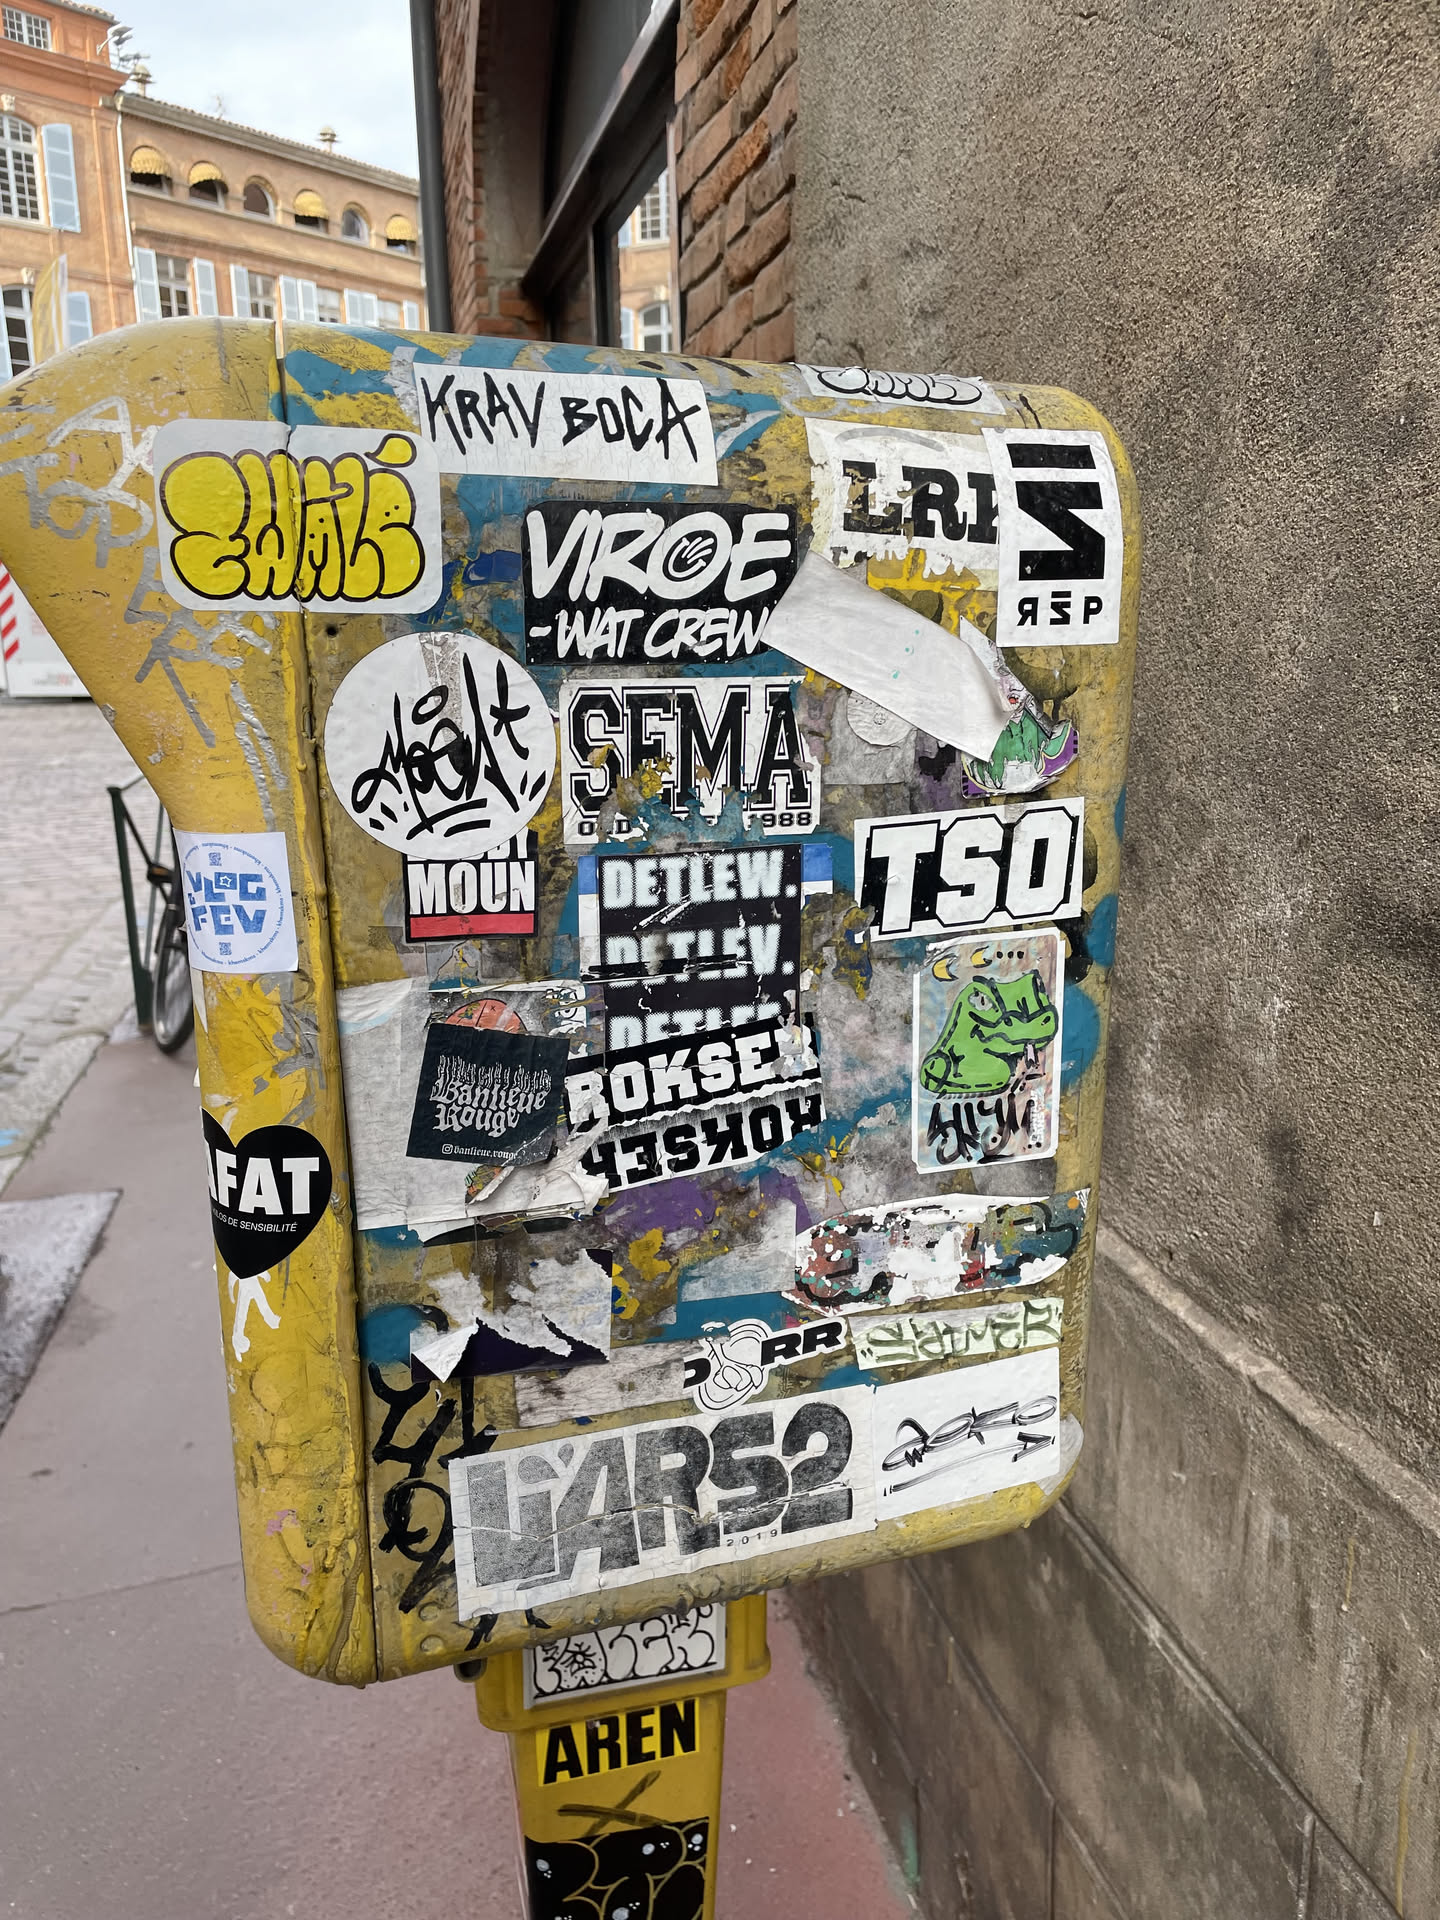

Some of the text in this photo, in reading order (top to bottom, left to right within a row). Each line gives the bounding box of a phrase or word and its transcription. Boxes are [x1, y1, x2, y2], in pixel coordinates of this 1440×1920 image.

[420, 371, 702, 463] KRAV BOCA
[526, 508, 792, 602] VIROE
[643, 606, 769, 659] CREW
[567, 684, 813, 818] SEMA
[407, 860, 534, 915] MOUN
[862, 806, 1075, 935] TSO
[191, 904, 267, 936] FEV
[430, 1056, 552, 1115] Banlieue
[433, 1102, 521, 1138] Rouge
[227, 1216, 240, 1228] DE
[239, 1220, 298, 1233] SENSIBILITÉ
[726, 1528, 778, 1547] 2019
[543, 1699, 697, 1785] AREN
